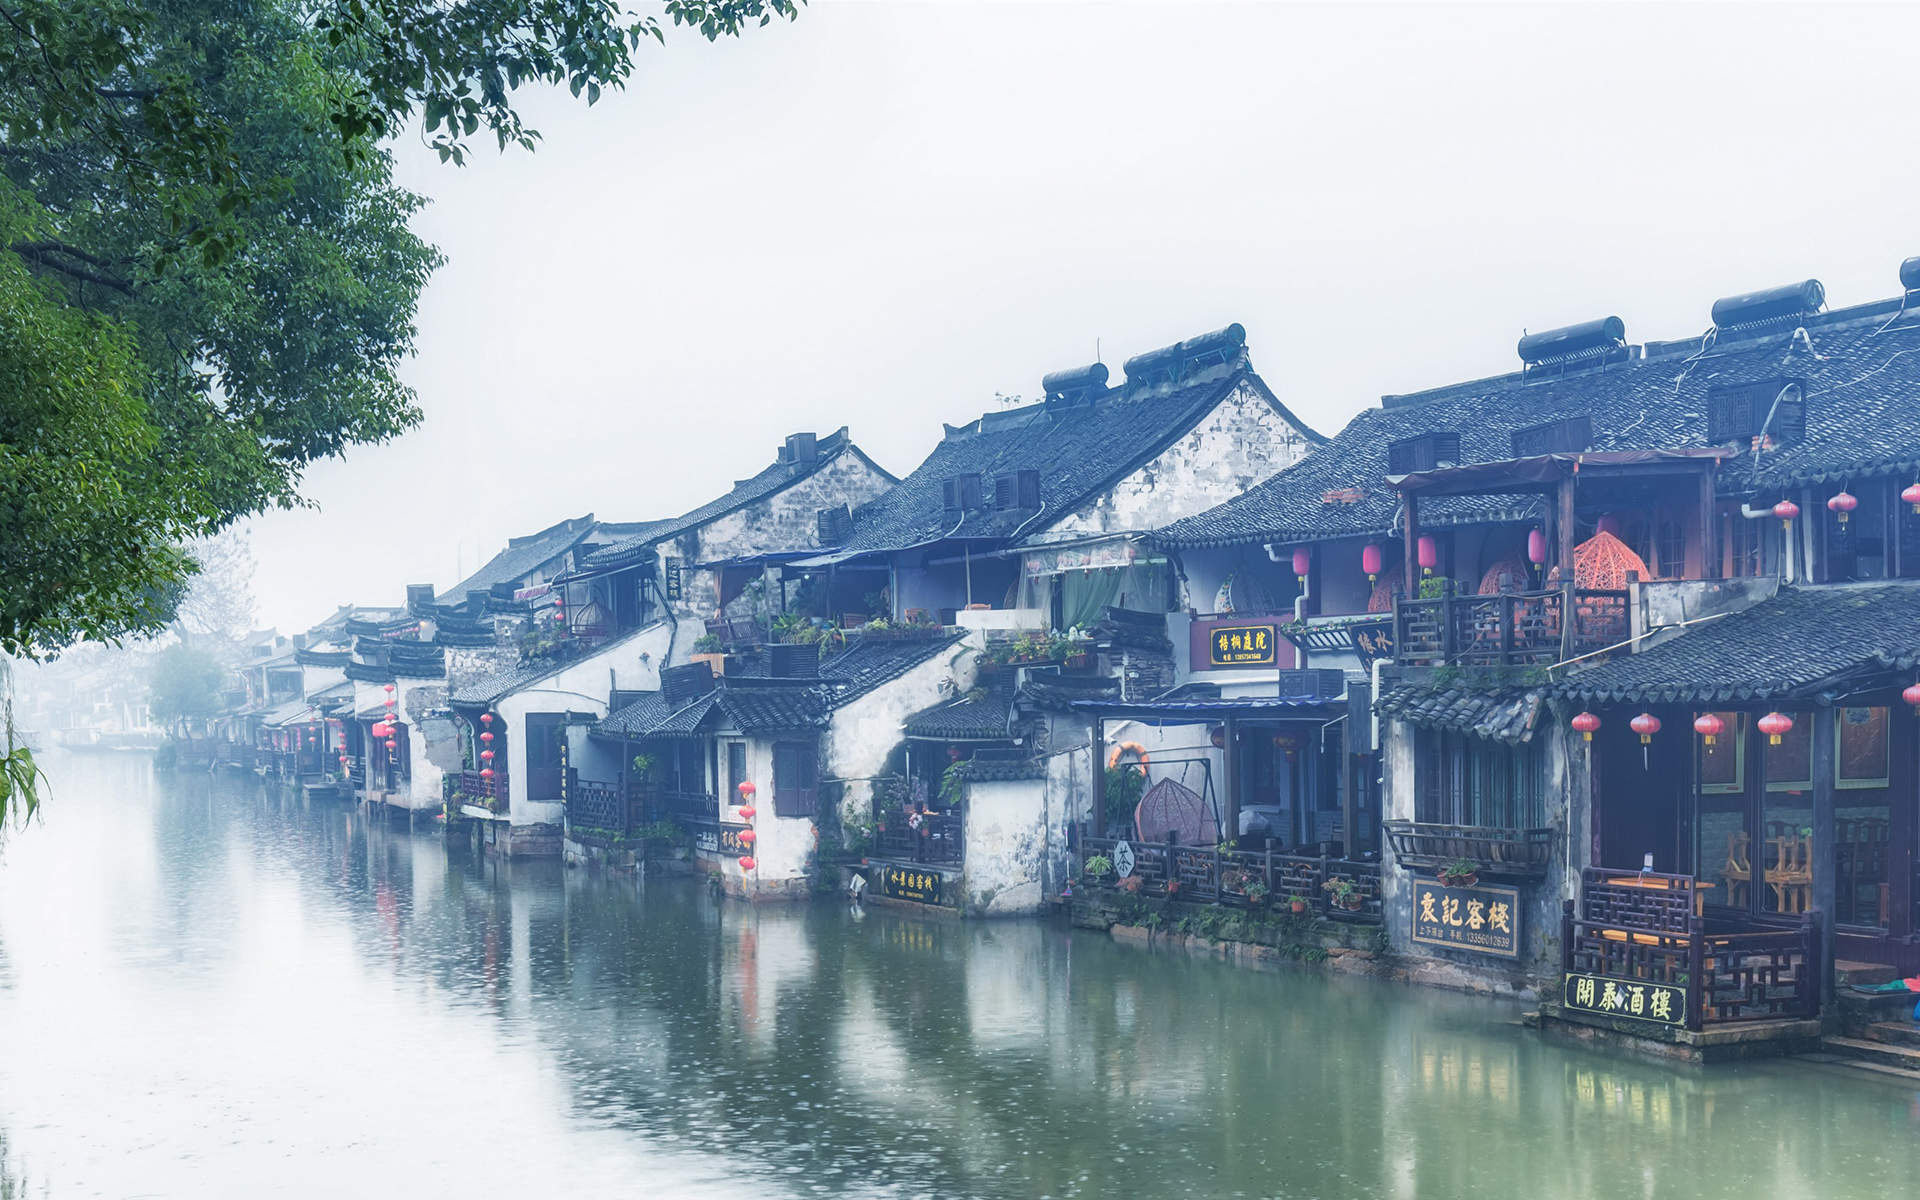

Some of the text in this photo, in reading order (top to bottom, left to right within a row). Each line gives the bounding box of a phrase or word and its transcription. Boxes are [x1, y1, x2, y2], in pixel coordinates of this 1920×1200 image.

[1116, 845, 1132, 872] 茶
[1576, 978, 1672, 1021] 開泰酒樓
